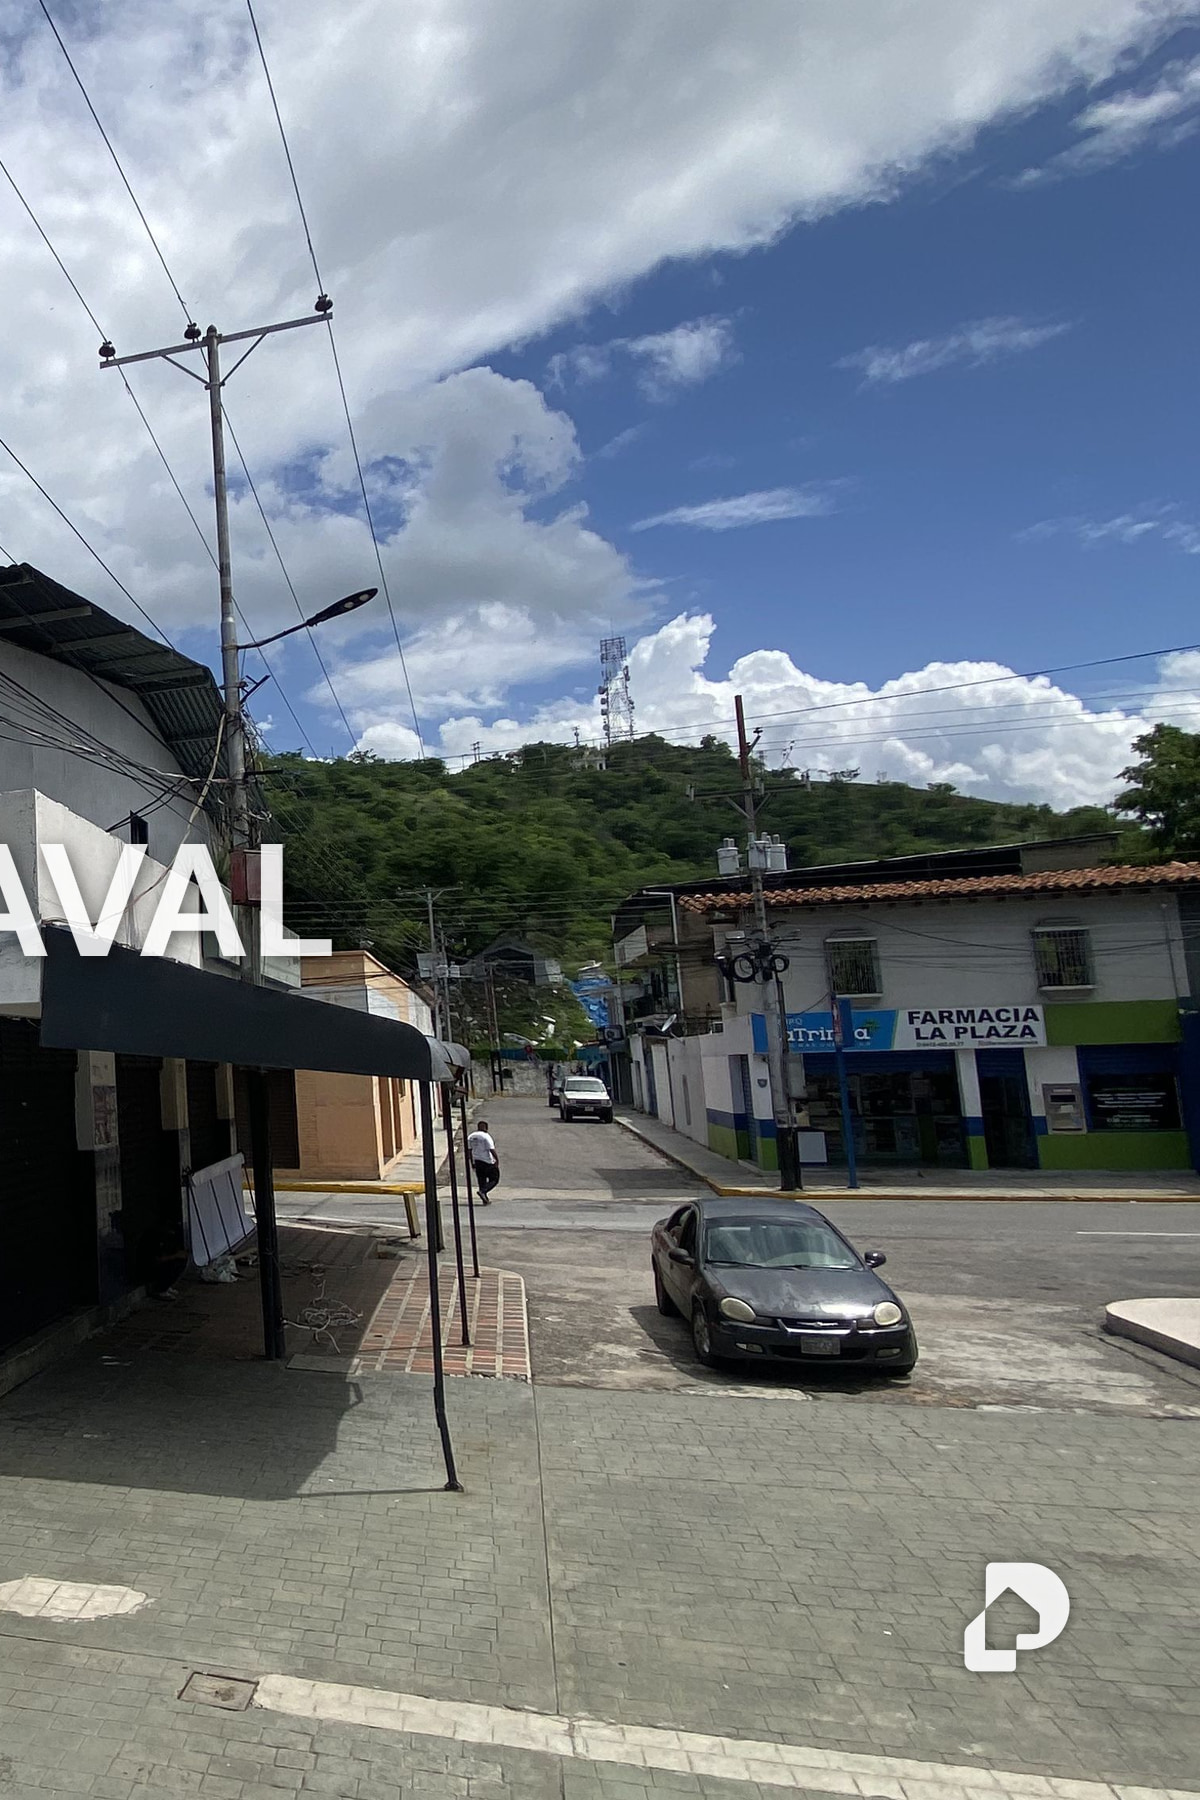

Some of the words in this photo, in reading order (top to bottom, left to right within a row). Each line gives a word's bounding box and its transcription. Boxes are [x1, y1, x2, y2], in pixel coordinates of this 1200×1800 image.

[907, 1008, 1040, 1025] FARMACIA
[914, 1027, 946, 1040] LA
[954, 1025, 1036, 1039] PLAZA
